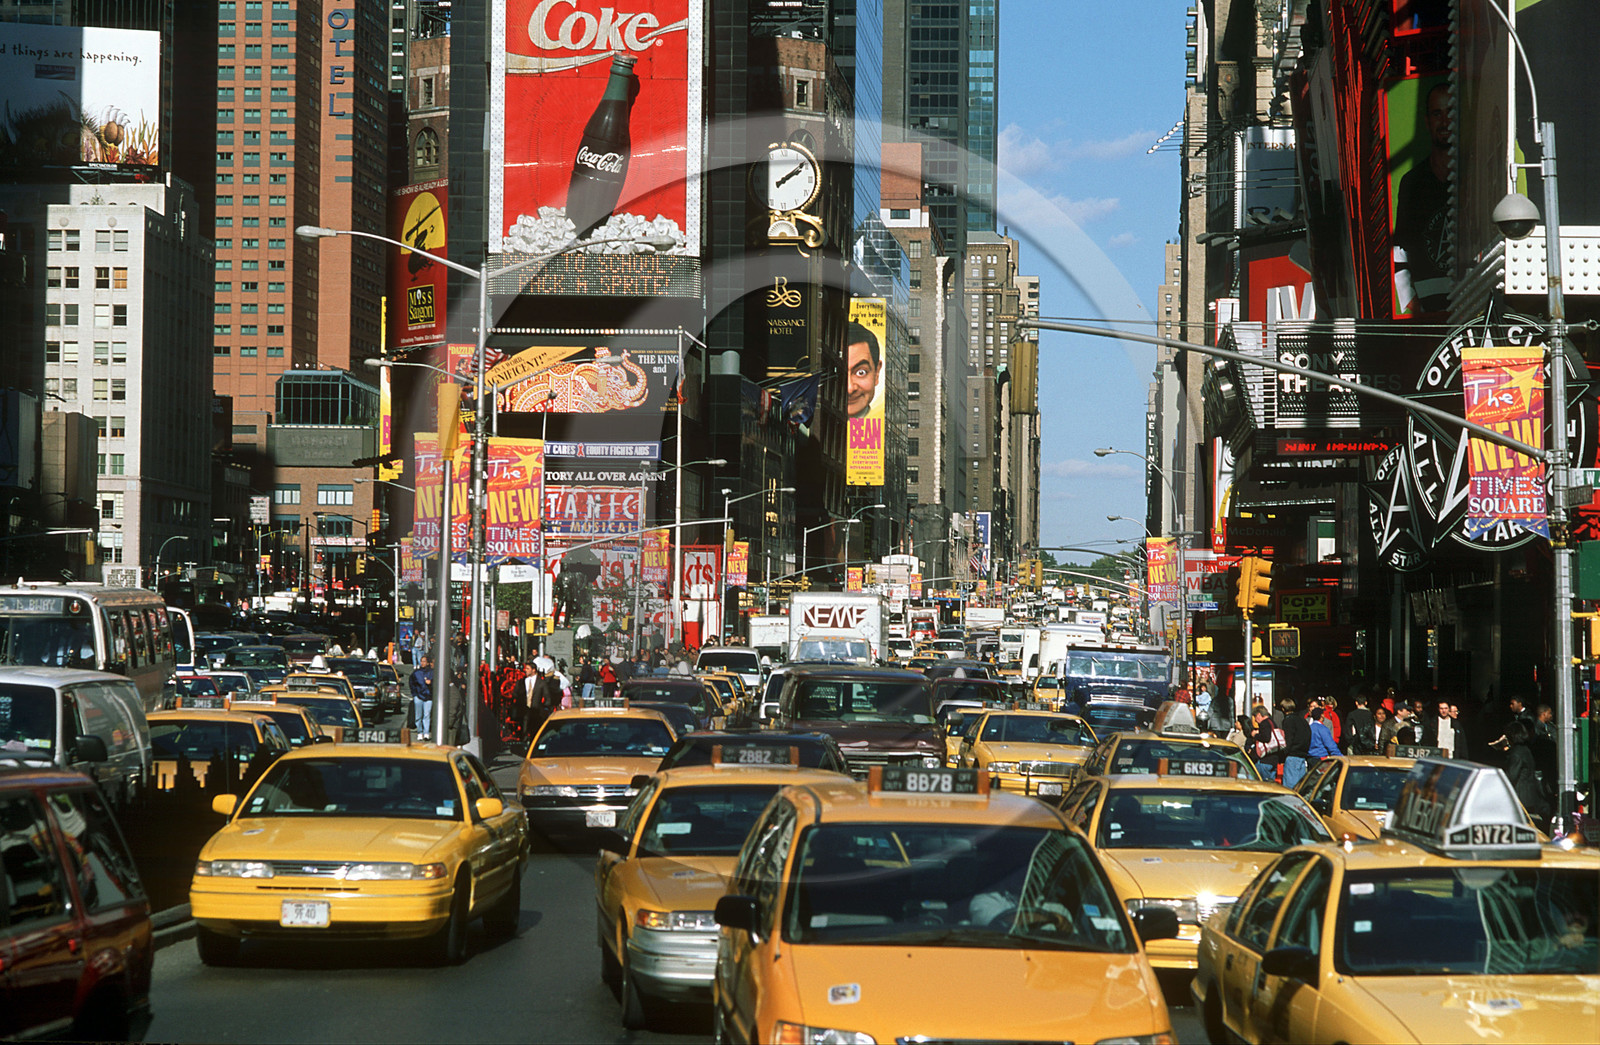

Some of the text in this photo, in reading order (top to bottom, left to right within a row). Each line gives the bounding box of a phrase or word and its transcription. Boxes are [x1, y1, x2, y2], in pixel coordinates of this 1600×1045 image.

[528, 0, 660, 51] Coke
[12, 43, 49, 61] things
[53, 49, 73, 59] are
[80, 48, 142, 66] happening.
[1247, 142, 1296, 150] INTERNA
[576, 146, 625, 174] Coca-Cola
[565, 253, 586, 273] TO
[518, 273, 671, 295] PACK A SPRITE!
[409, 289, 433, 306] Miss
[856, 302, 884, 310] Everything
[409, 305, 434, 323] Saigon
[850, 311, 884, 320] you've heard
[769, 327, 793, 335] HOTEL
[637, 354, 679, 365] THE KING
[1279, 351, 1345, 371] SONY
[486, 352, 548, 387] AGNIFICENT!"
[652, 364, 667, 374] and
[663, 376, 667, 386] I
[1278, 373, 1402, 394] THEATRES
[1463, 378, 1514, 408] The
[849, 417, 881, 449] BEAN
[552, 445, 576, 455] CARES
[586, 445, 609, 456] EQUITY
[609, 445, 634, 456] FIGHTS
[633, 445, 650, 456] AIDS
[1470, 417, 1542, 474] NEW
[488, 459, 521, 480] The
[574, 471, 591, 481] ALL
[597, 471, 627, 481] OVER
[628, 471, 666, 482] AGAIN!
[1470, 476, 1544, 496] TIMES
[416, 482, 468, 519] NEW
[488, 487, 540, 524] NEW
[547, 493, 635, 520] TANIC
[1469, 496, 1545, 517] SQUARE
[413, 521, 467, 536] TIMES
[486, 526, 540, 541] TIMES
[570, 521, 633, 533] MUSICAL
[1227, 526, 1292, 537] McDonald
[412, 535, 468, 550] SQURE
[486, 541, 540, 556] SQUARE
[644, 550, 668, 567] NEW
[1147, 549, 1166, 561] The
[1391, 552, 1421, 567] STAR
[402, 556, 422, 570] NEW
[727, 560, 748, 574] NEW
[1149, 563, 1177, 584] NEW
[1148, 585, 1177, 593] TIMES
[1148, 592, 1177, 601] SQUARE
[1273, 646, 1297, 655] WALK
[358, 730, 386, 743] 9F40
[1407, 747, 1431, 758] 9J87
[1184, 761, 1214, 776] 6K93
[884, 780, 974, 792] DUTY DUTY
[886, 771, 971, 792] OFF 8B78 OFF
[1473, 824, 1511, 845] 3Y72
